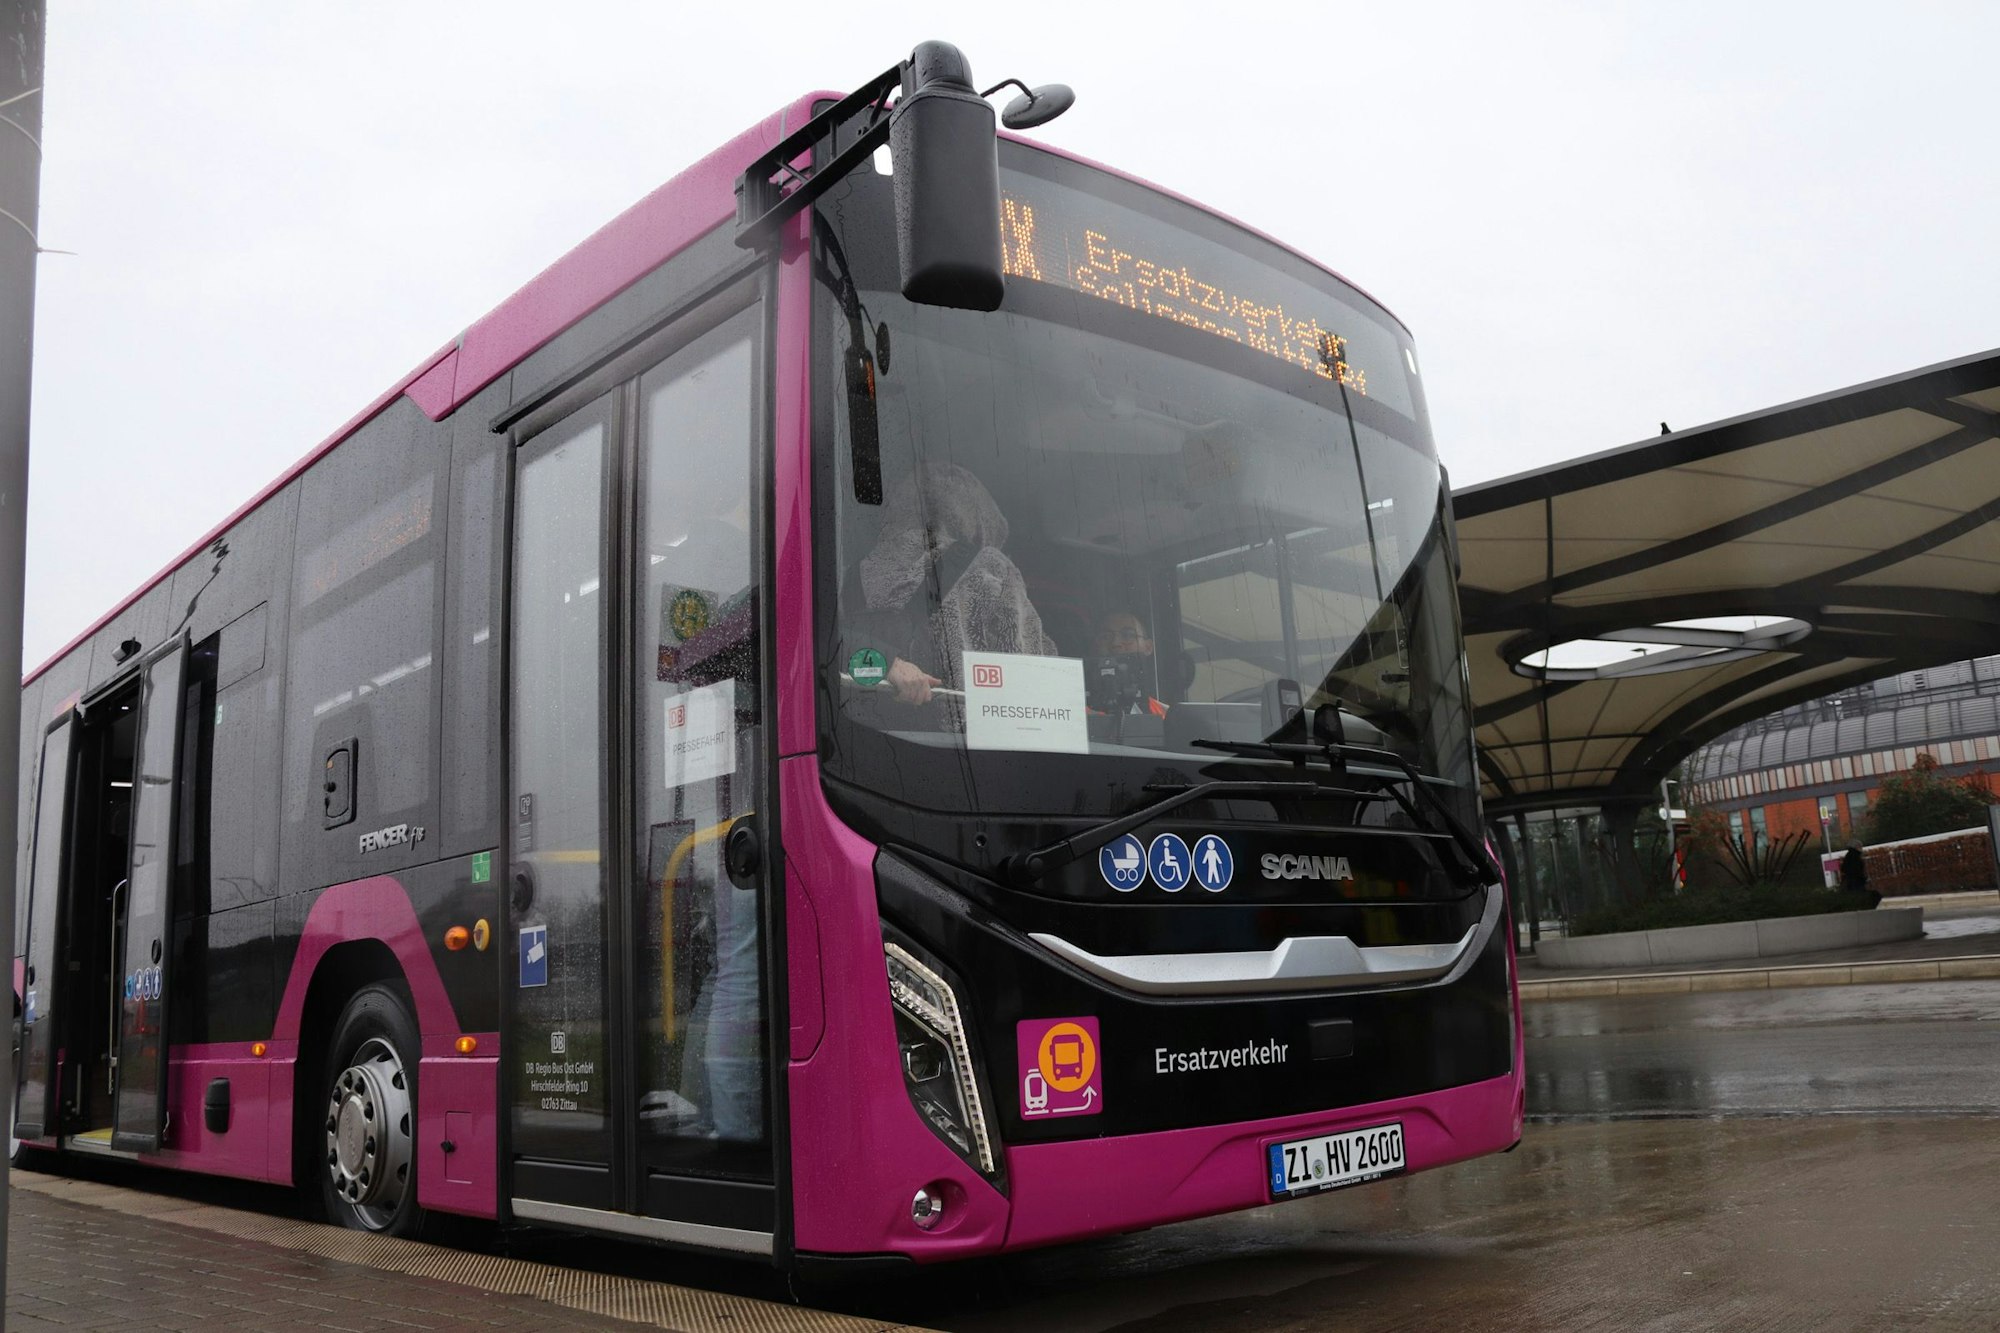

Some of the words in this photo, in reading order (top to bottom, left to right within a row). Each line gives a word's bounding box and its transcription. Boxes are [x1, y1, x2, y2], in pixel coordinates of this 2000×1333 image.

[1086, 229, 1348, 357] Ersatzverkehr
[862, 650, 873, 667] 4
[976, 668, 999, 684] DB
[982, 705, 1072, 720] PRESSEFAHRT
[672, 731, 725, 755] PRESSEFAHRT
[359, 823, 409, 854] FENCER
[1260, 853, 1353, 881] SCANIA
[1155, 1038, 1289, 1074] Ersatzverkehr
[525, 1062, 534, 1074] DB
[535, 1062, 551, 1076] Regio
[552, 1062, 563, 1074] Bus
[564, 1062, 574, 1074] Ost
[575, 1061, 594, 1074] GmbH
[530, 1080, 565, 1092] Hirschfelder
[565, 1080, 579, 1095] Ring
[580, 1080, 588, 1092] 10
[541, 1097, 559, 1110] 02763
[560, 1098, 577, 1111] Zittau
[1285, 1145, 1312, 1184] ZI
[1326, 1138, 1350, 1176] HV
[1355, 1129, 1401, 1170] 2600
[1275, 1173, 1282, 1184] D
